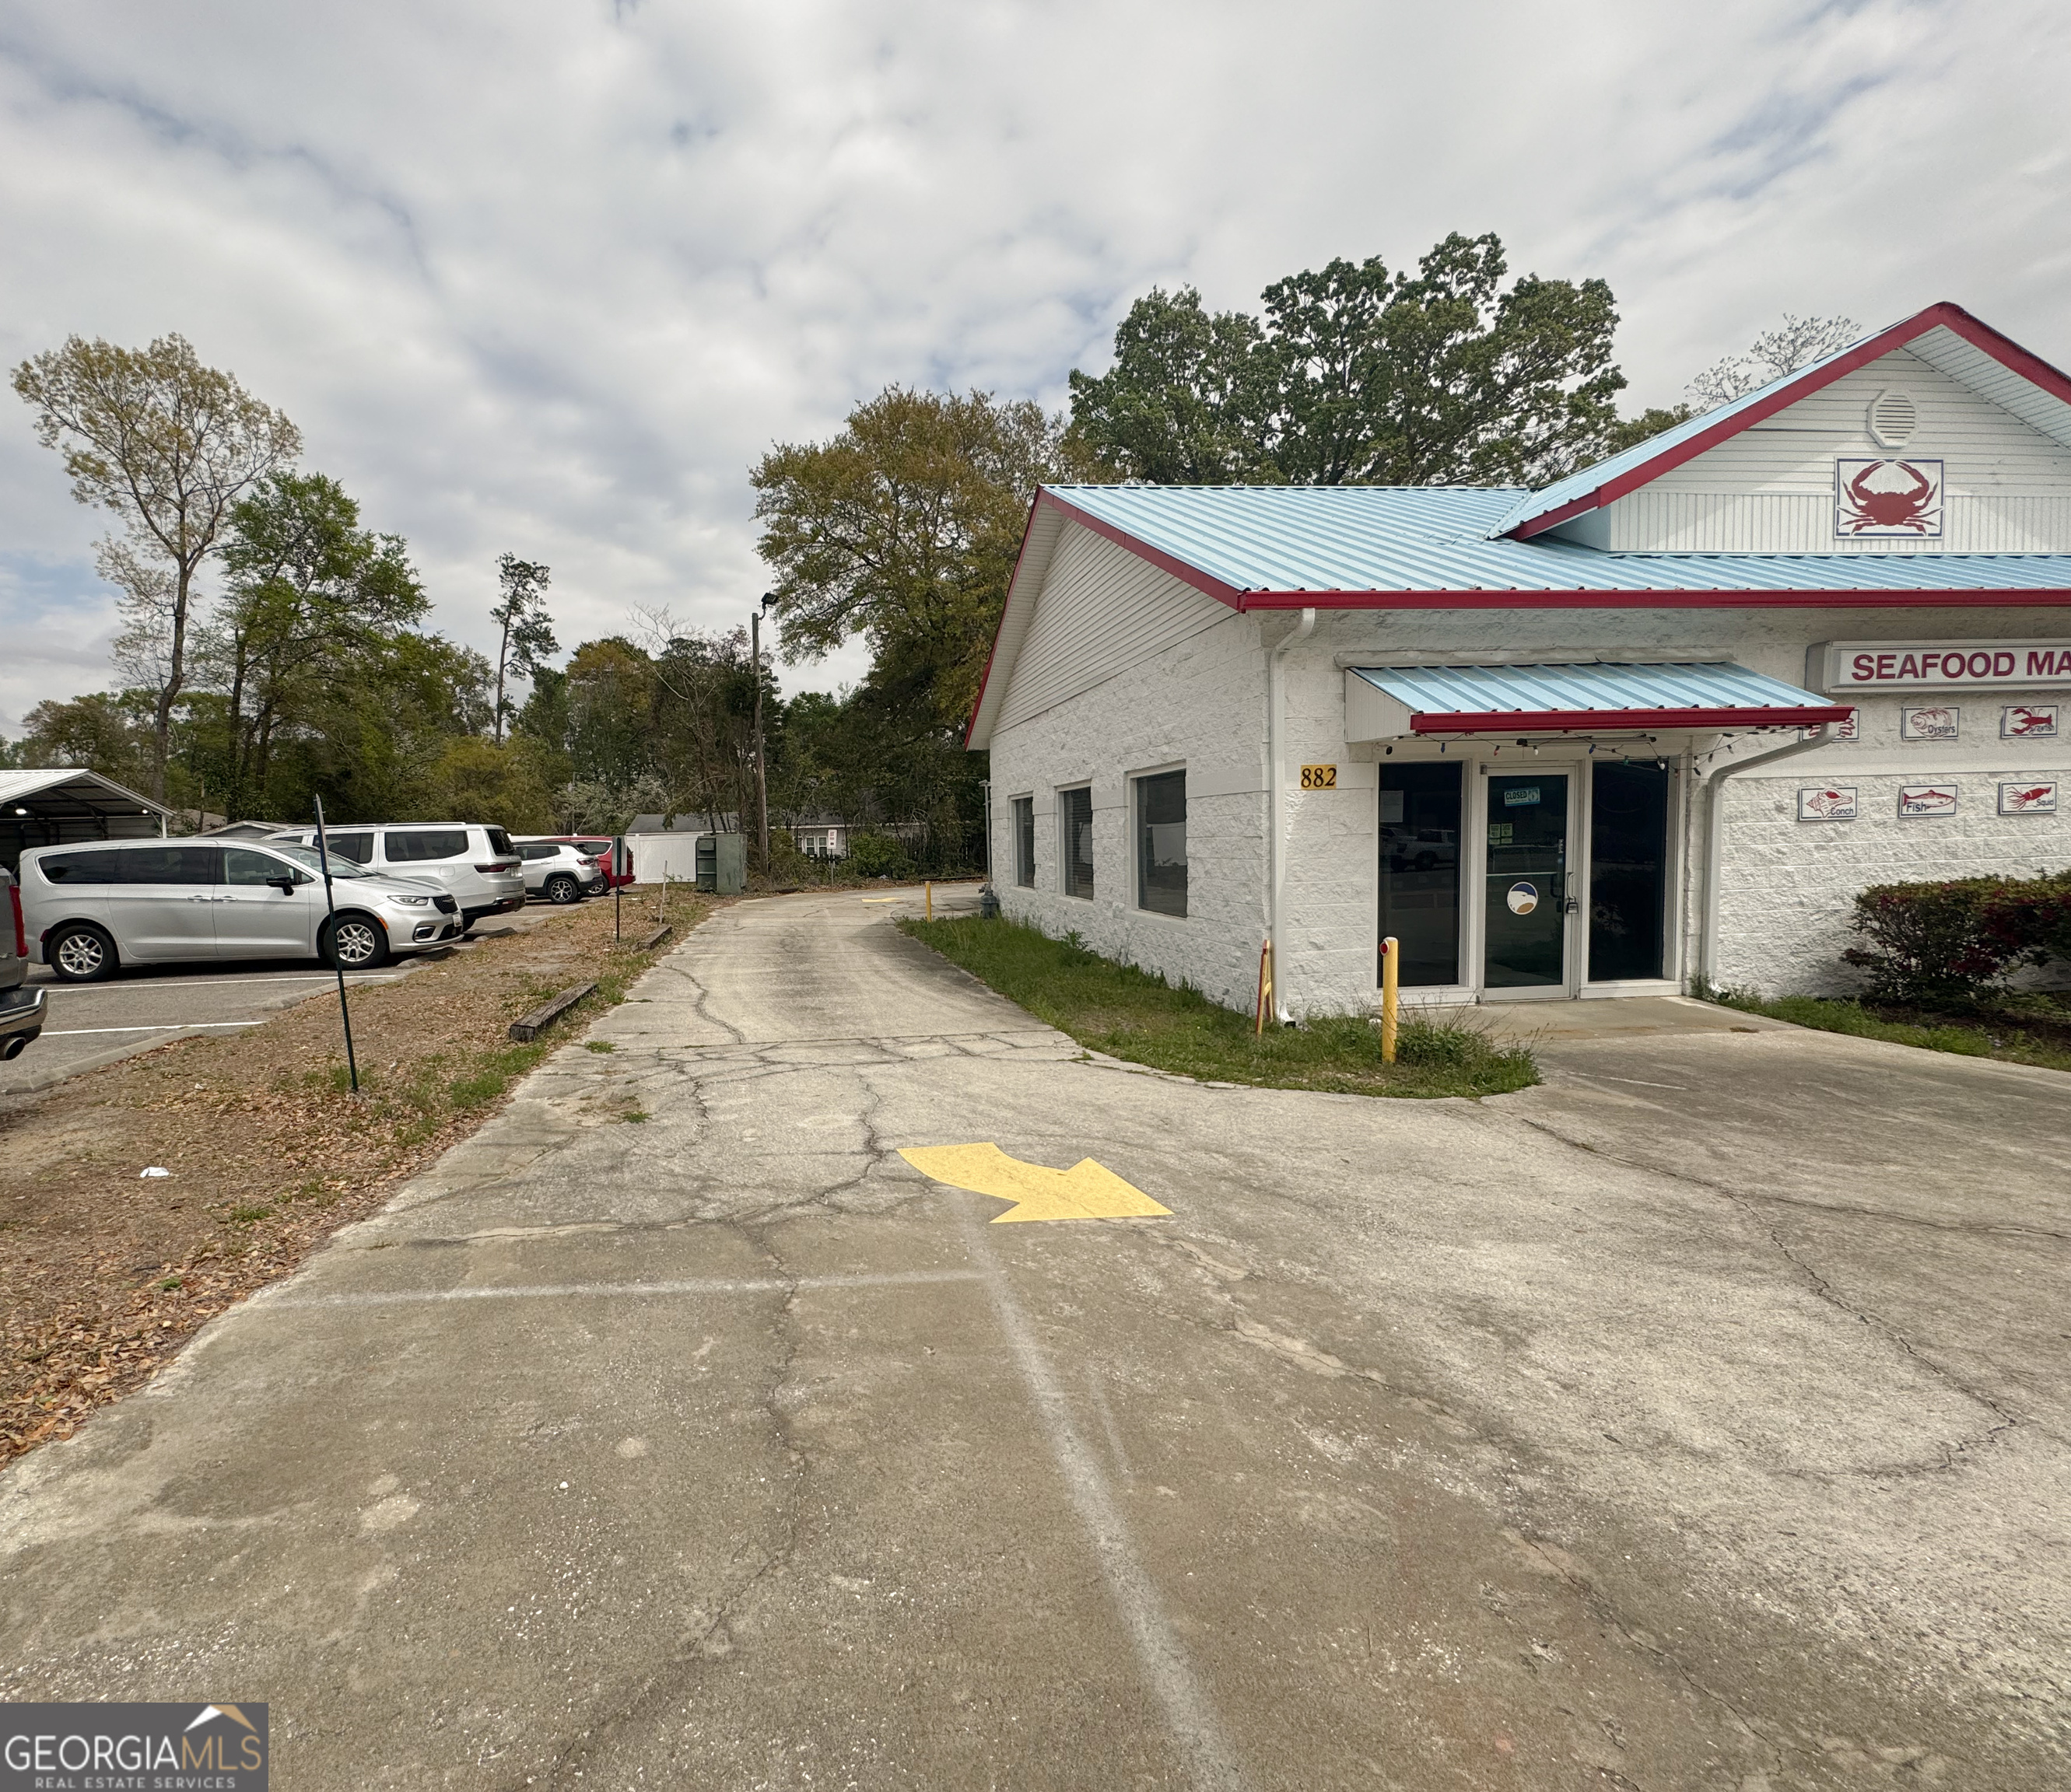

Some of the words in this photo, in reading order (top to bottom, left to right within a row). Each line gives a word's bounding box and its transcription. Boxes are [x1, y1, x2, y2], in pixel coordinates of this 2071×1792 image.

[1851, 652, 2016, 681] SEAFOOD
[1928, 724, 1956, 735] Oysters
[1301, 767, 1337, 788] 882
[1505, 790, 1527, 800] CLOSED
[1831, 807, 1854, 816] Conch
[1906, 801, 1927, 812] Fish
